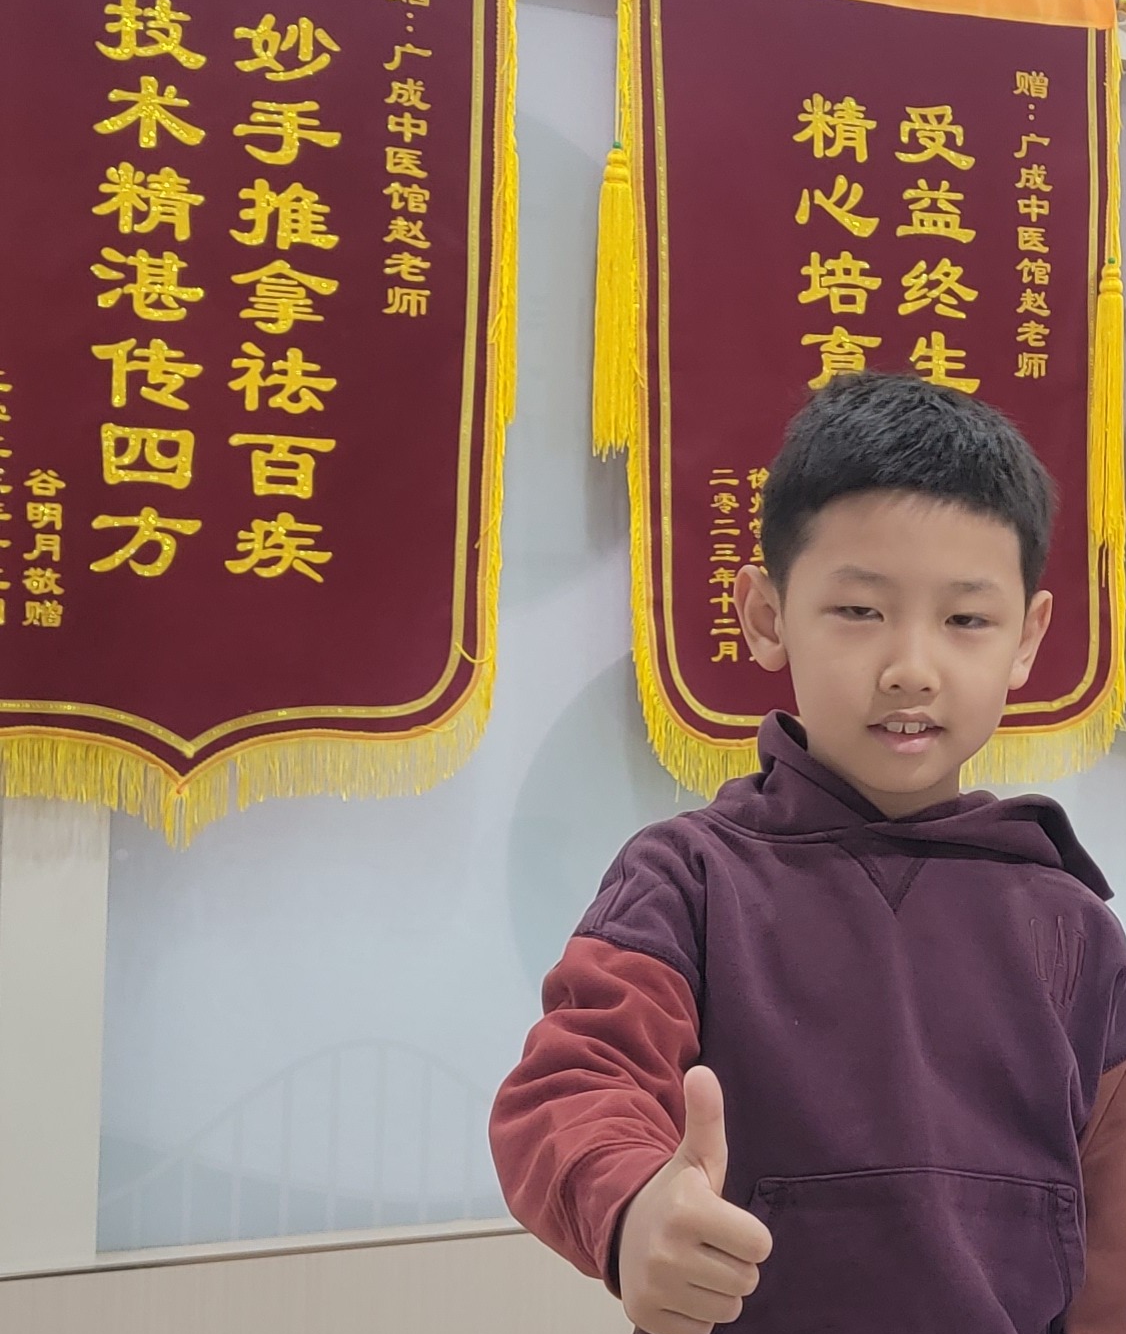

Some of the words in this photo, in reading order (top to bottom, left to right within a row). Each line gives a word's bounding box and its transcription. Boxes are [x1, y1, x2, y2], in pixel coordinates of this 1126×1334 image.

[225, 14, 341, 582] 妙手推拿祛百疾
[793, 93, 882, 389] 精心培育
[895, 105, 980, 394] 受益终生
[23, 469, 65, 626] 谷明月敬赠
[709, 469, 742, 662] 二零二三年十二月
